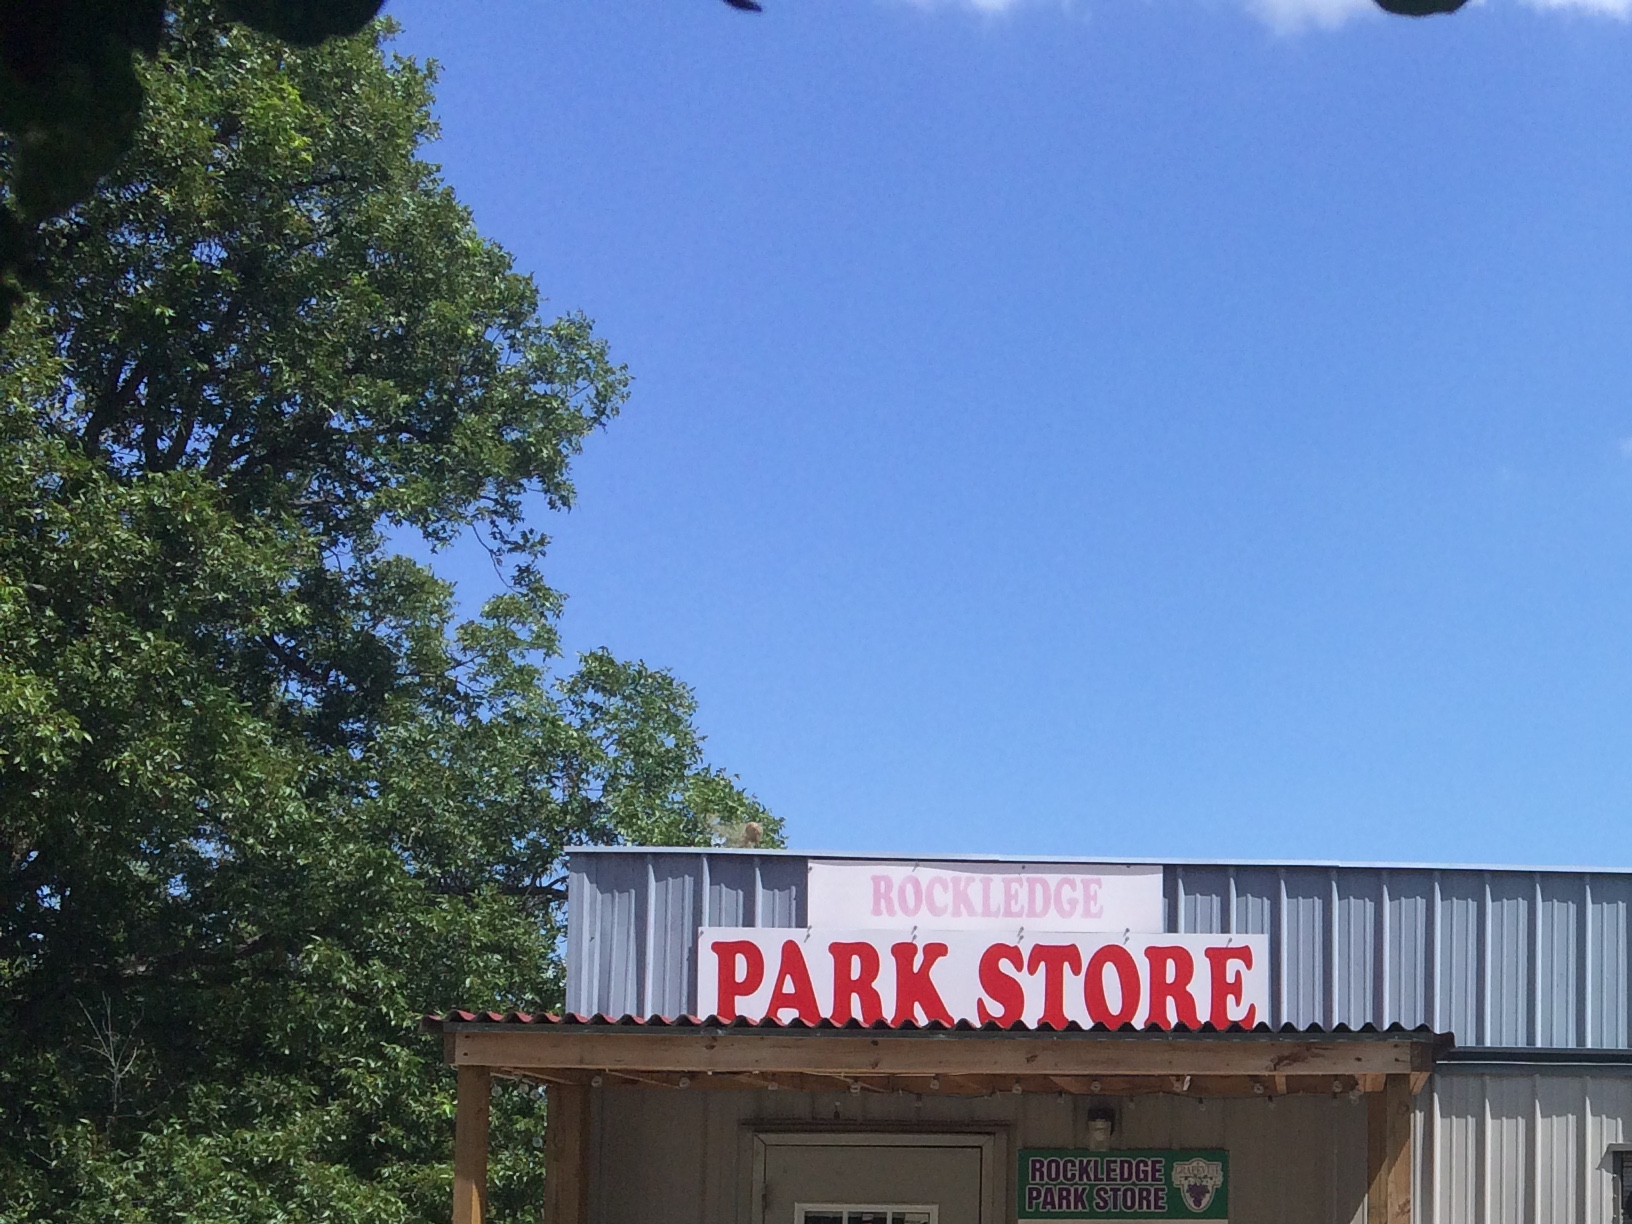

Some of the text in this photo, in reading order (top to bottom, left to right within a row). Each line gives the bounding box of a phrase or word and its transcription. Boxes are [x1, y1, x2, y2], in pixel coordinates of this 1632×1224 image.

[871, 875, 1104, 918] ROCKLEDGE
[710, 939, 1257, 1031] PARK STORE
[1029, 1157, 1165, 1183] ROCKLEDGE
[1026, 1186, 1167, 1212] PARK STORE
